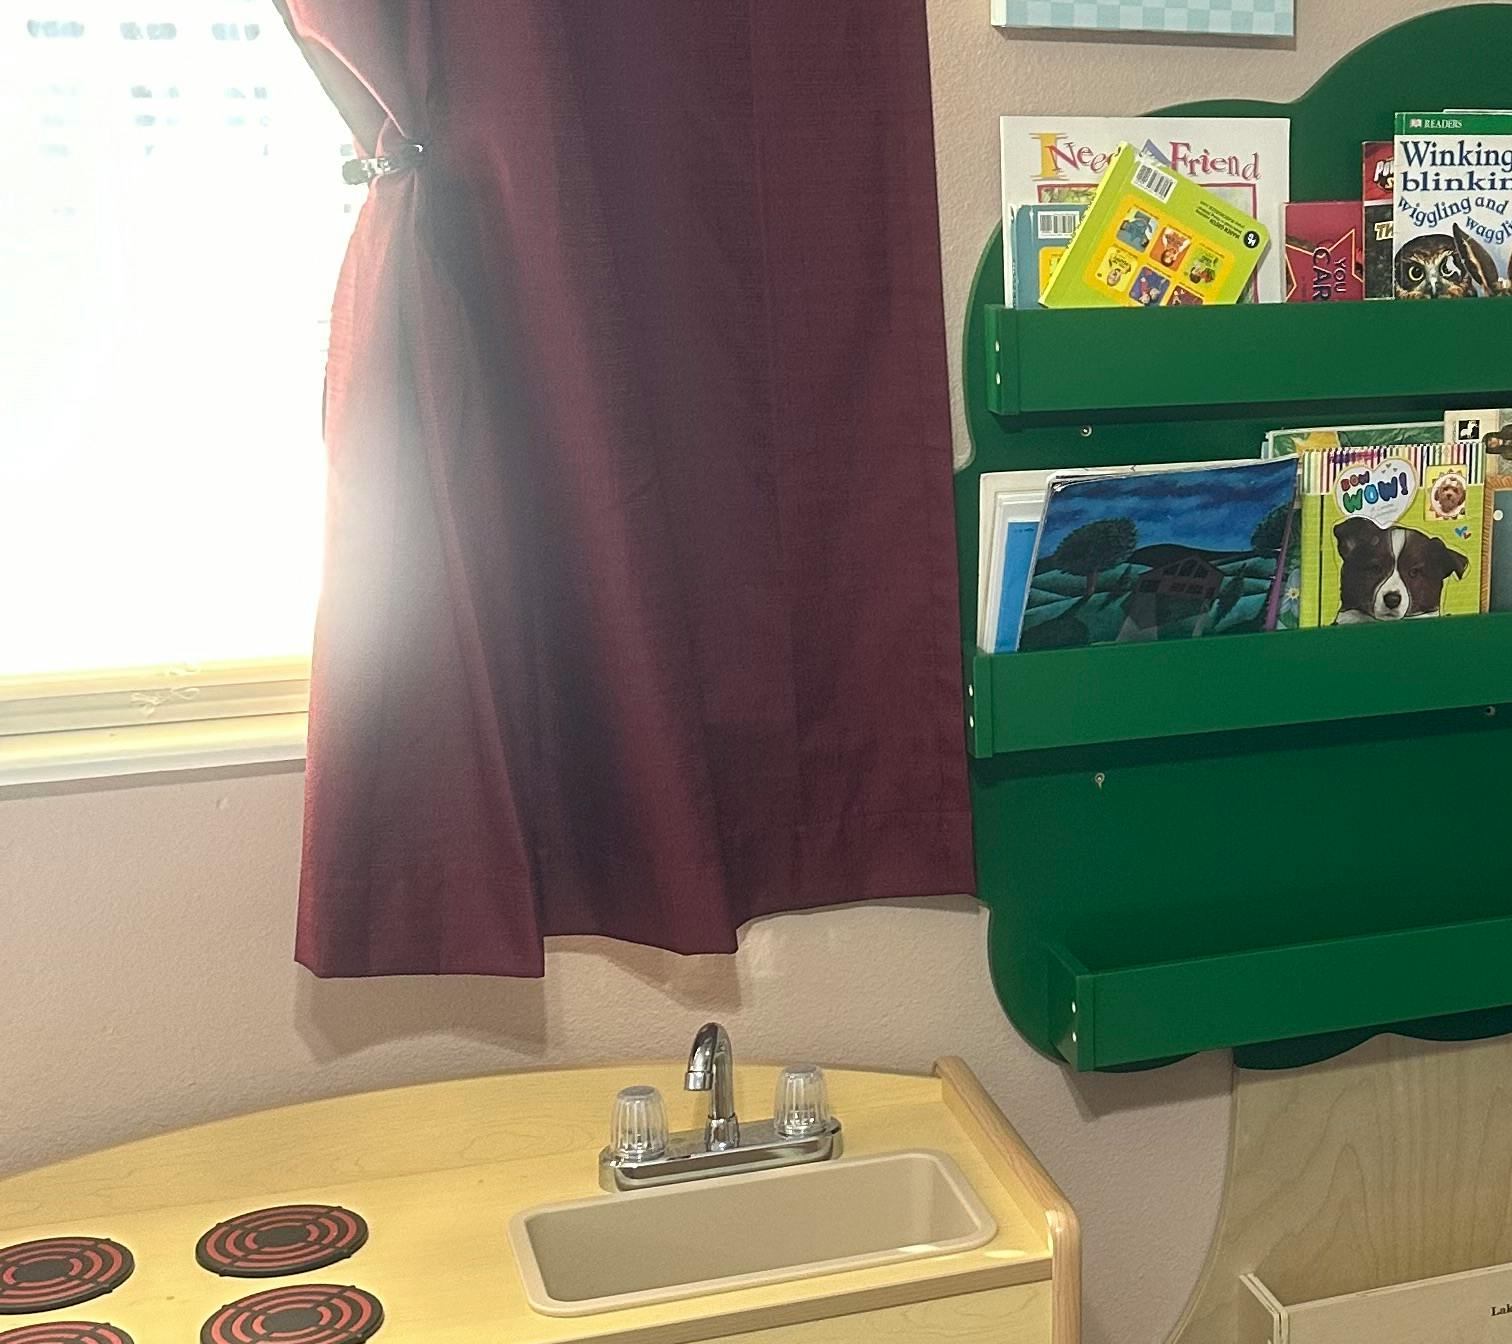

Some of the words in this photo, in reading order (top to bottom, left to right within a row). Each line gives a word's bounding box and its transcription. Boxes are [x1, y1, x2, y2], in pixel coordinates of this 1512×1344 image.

[1424, 119, 1463, 129] READERS
[1029, 133, 1069, 181] I
[1169, 141, 1262, 180] Friend
[1398, 196, 1472, 228] wiggling
[1475, 196, 1510, 215] and
[1334, 257, 1347, 293] YOU
[1341, 471, 1370, 491] BOW
[1342, 471, 1409, 513] WOW!
